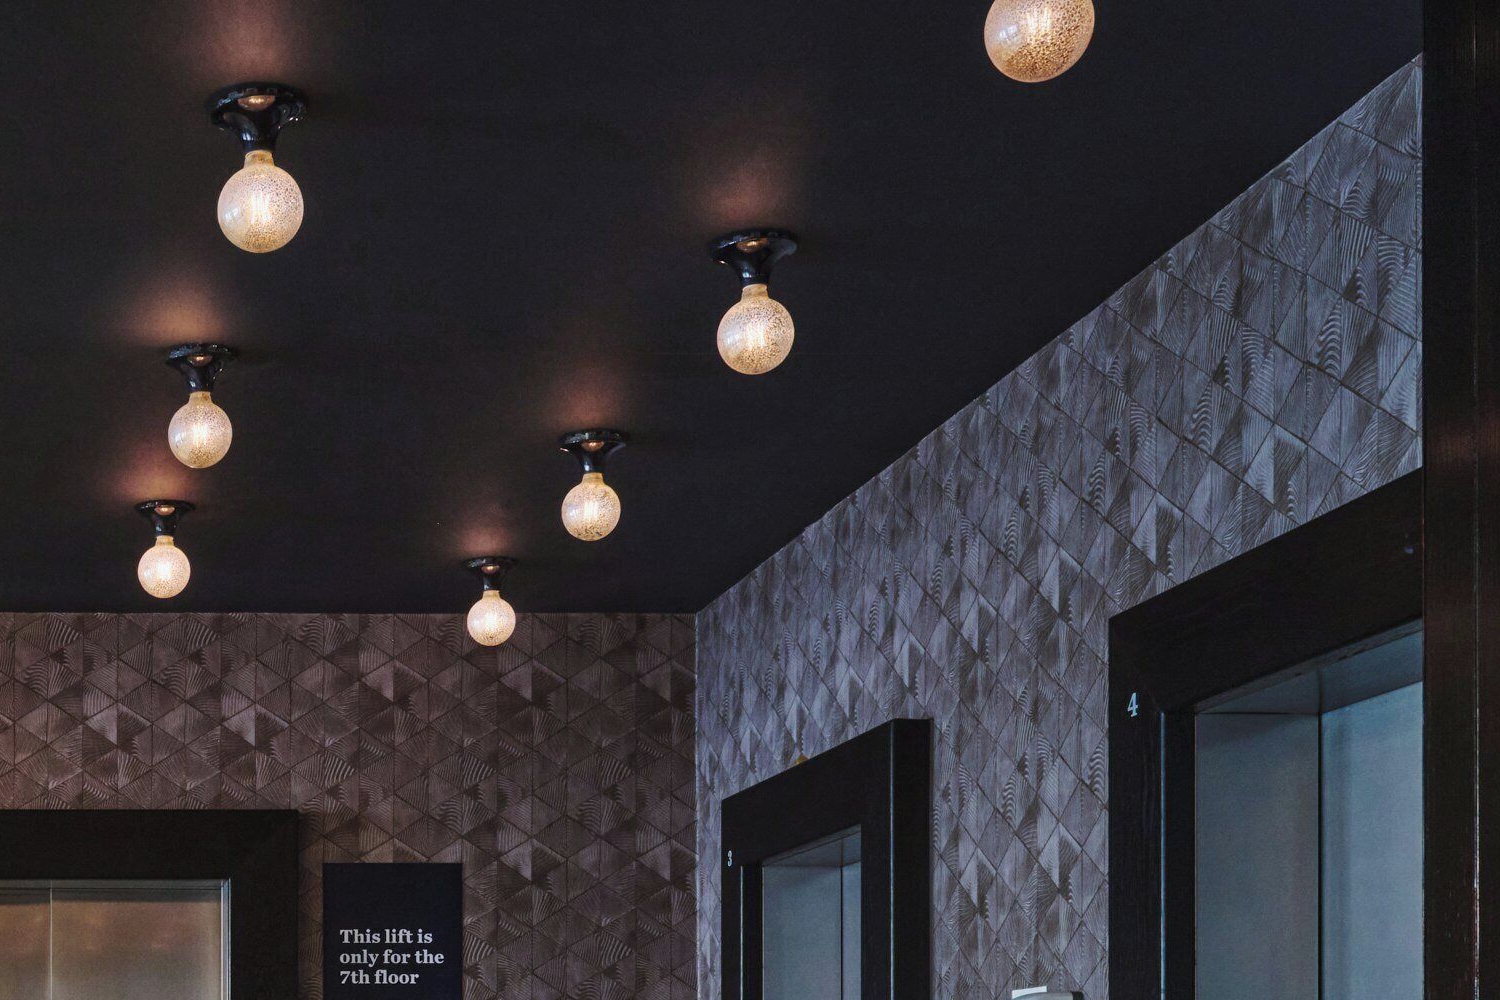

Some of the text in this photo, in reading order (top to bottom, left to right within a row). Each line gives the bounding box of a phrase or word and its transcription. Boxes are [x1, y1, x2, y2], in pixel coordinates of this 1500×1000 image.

[1127, 692, 1139, 718] 4
[727, 850, 733, 867] 3
[339, 928, 433, 944] This lift is
[339, 949, 445, 968] only for the
[340, 969, 420, 984] 7th floor
